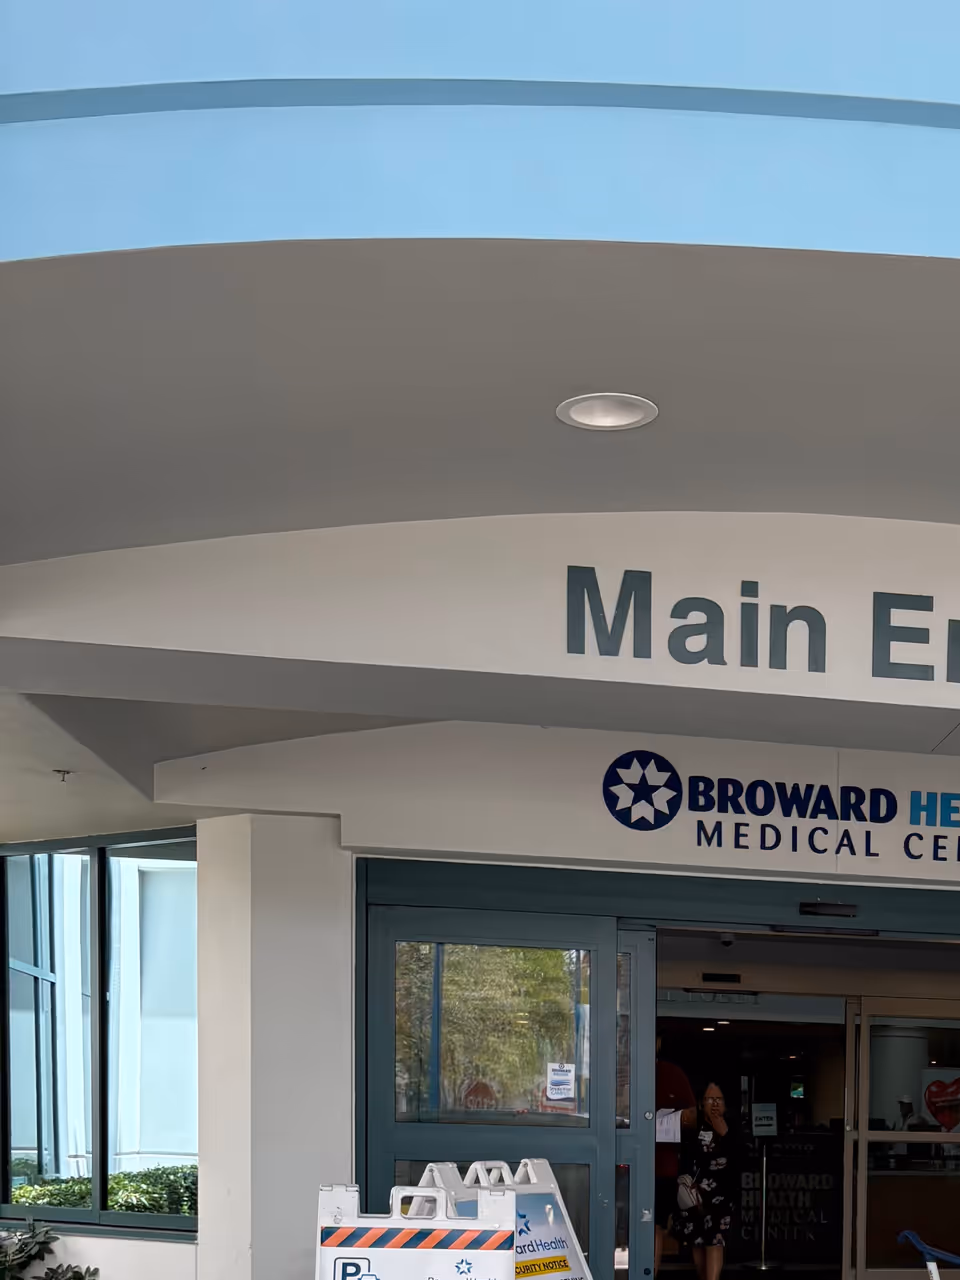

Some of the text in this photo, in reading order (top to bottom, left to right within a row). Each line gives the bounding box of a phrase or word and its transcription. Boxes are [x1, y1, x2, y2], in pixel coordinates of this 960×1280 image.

[566, 565, 827, 673] Main
[688, 776, 897, 824] BROWARD
[696, 820, 879, 857] MEDICAL
[534, 1237, 569, 1251] Health
[515, 1259, 569, 1274] CURITY NOTICE
